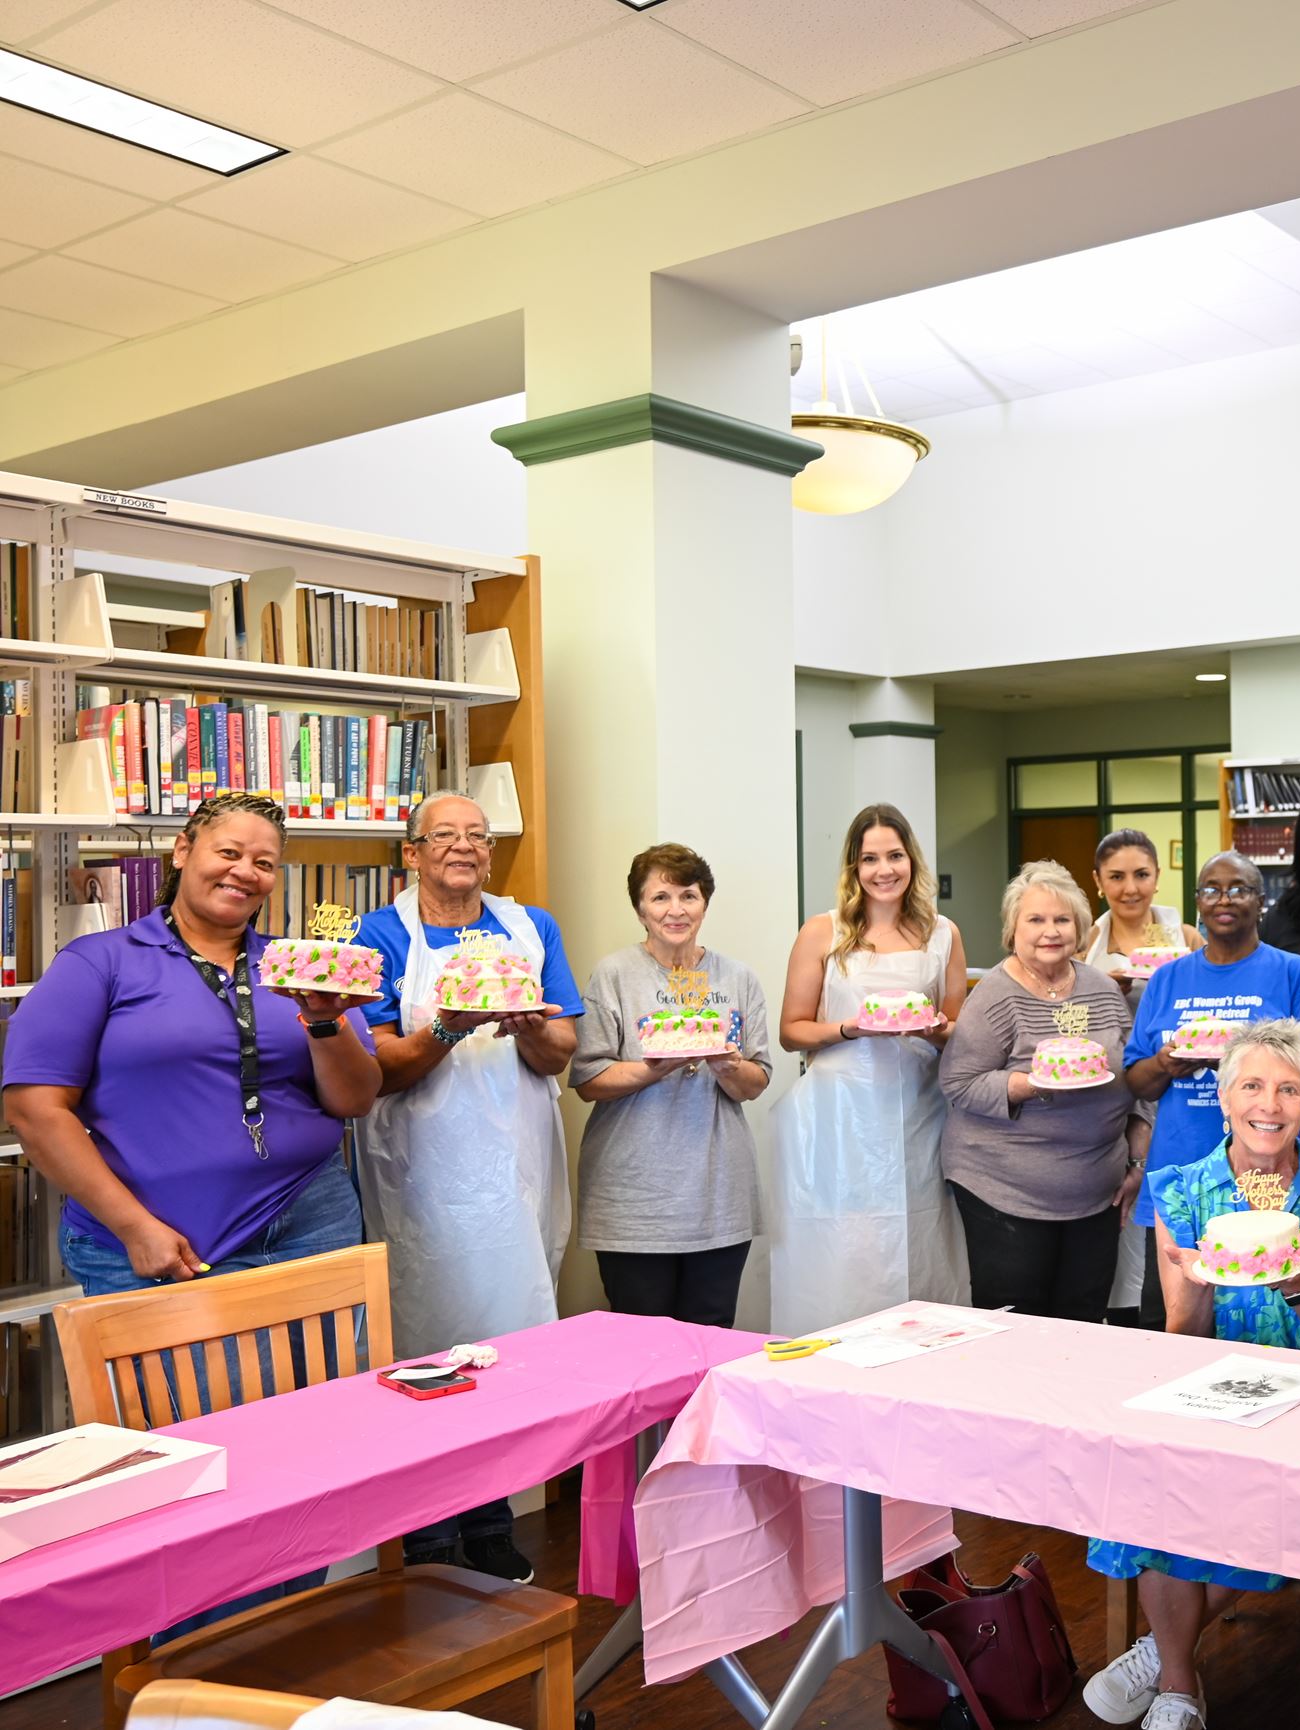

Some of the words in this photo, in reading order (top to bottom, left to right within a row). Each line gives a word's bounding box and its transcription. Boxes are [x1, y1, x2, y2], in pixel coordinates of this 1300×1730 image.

[96, 493, 118, 503] NEW
[121, 497, 155, 509] BOOKS
[188, 722, 199, 759] CONNIE
[403, 745, 412, 779] TURNER
[711, 991, 731, 1004] the
[1193, 995, 1233, 1007] Women's
[1234, 994, 1263, 1007] Group
[1216, 1007, 1251, 1019] Retreat
[1235, 1168, 1284, 1187] Happy
[1250, 1194, 1289, 1210] Day
